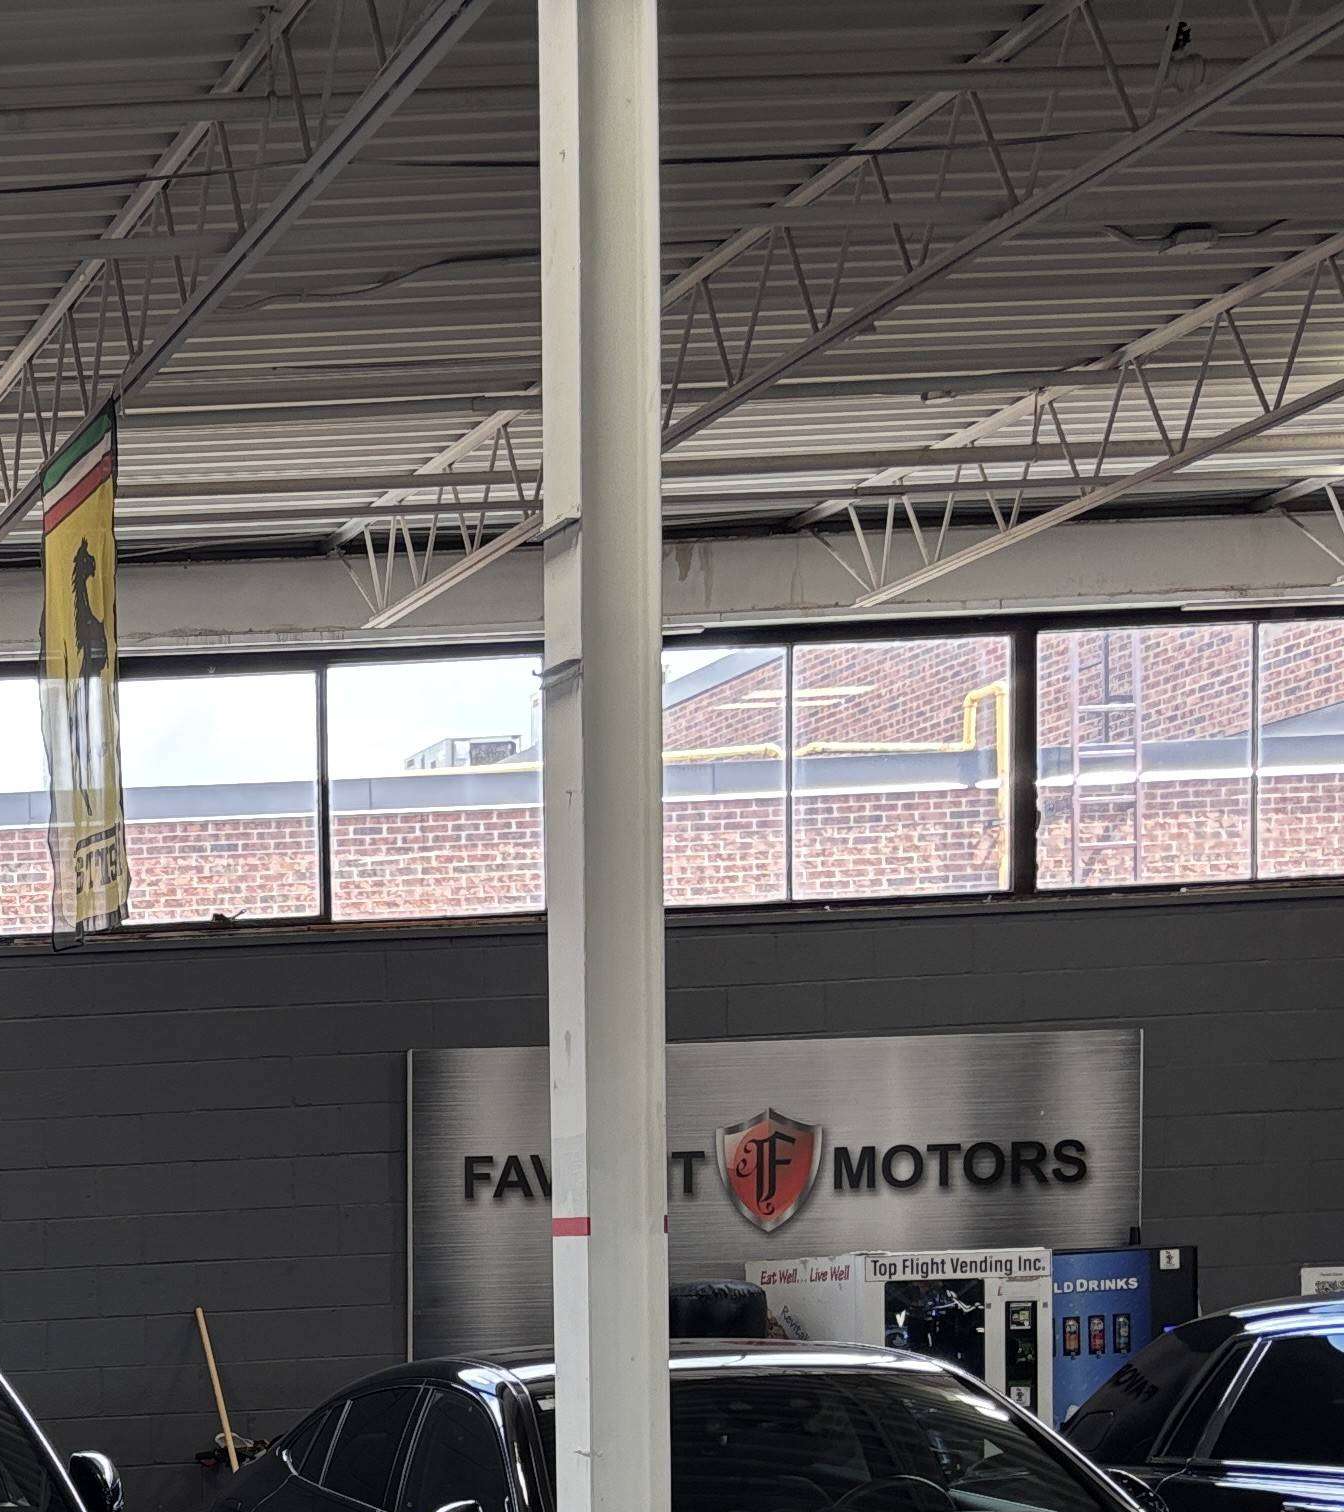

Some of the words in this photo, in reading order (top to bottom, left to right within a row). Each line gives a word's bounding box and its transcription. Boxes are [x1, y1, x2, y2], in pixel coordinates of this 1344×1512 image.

[833, 1139, 1087, 1189] MOTORS
[761, 1270, 777, 1285] Eat
[810, 1267, 828, 1282] Live
[830, 1265, 850, 1281] Well
[871, 1259, 897, 1279] Top
[903, 1257, 946, 1278] Flight
[951, 1255, 1013, 1276] Vending
[1018, 1255, 1046, 1271] Inc.
[1076, 1277, 1139, 1292] DRINKS
